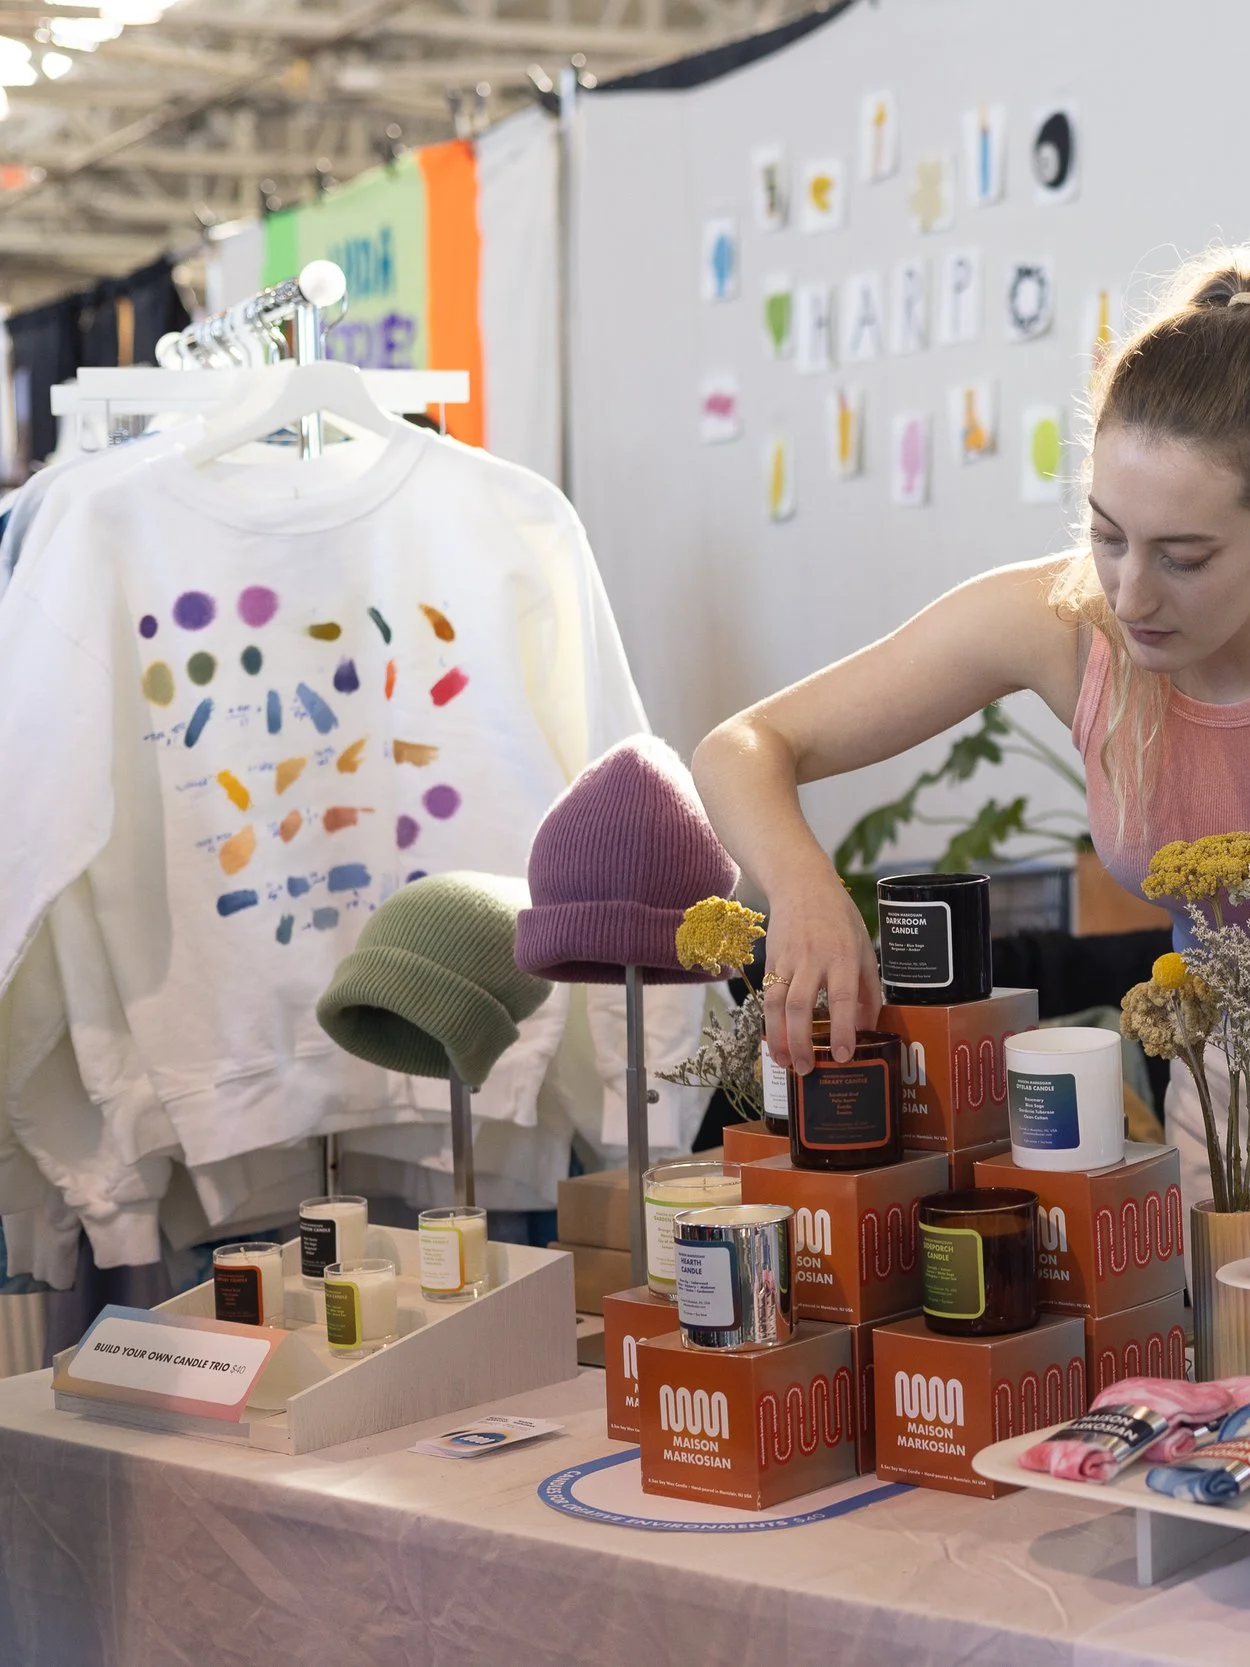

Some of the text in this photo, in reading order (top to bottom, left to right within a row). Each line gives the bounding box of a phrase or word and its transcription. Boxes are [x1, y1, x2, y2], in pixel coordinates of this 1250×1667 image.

[886, 917, 927, 925] DARKROOM
[891, 927, 919, 935] CANDLE
[681, 1257, 702, 1266] HEARTH
[797, 1255, 821, 1269] SON
[927, 1251, 949, 1261] CANDLE
[681, 1266, 703, 1275] CANDLE
[796, 1271, 833, 1285] OSIAN
[94, 1342, 247, 1375] BUILD YOUR OWN CANDLE TRIO $40
[1082, 1414, 1134, 1426] MAISON
[907, 1422, 953, 1439] MAISON
[1071, 1422, 1138, 1443] ARKOSIAN
[673, 1436, 718, 1452] MAISON
[897, 1435, 966, 1457] MARKOSIAN
[664, 1449, 731, 1469] MARKOSIAN
[546, 1471, 581, 1494] CANDLES
[547, 1494, 570, 1504] FOR
[562, 1503, 626, 1521] CREATIVE
[626, 1518, 788, 1530] ENVIRONMENTS
